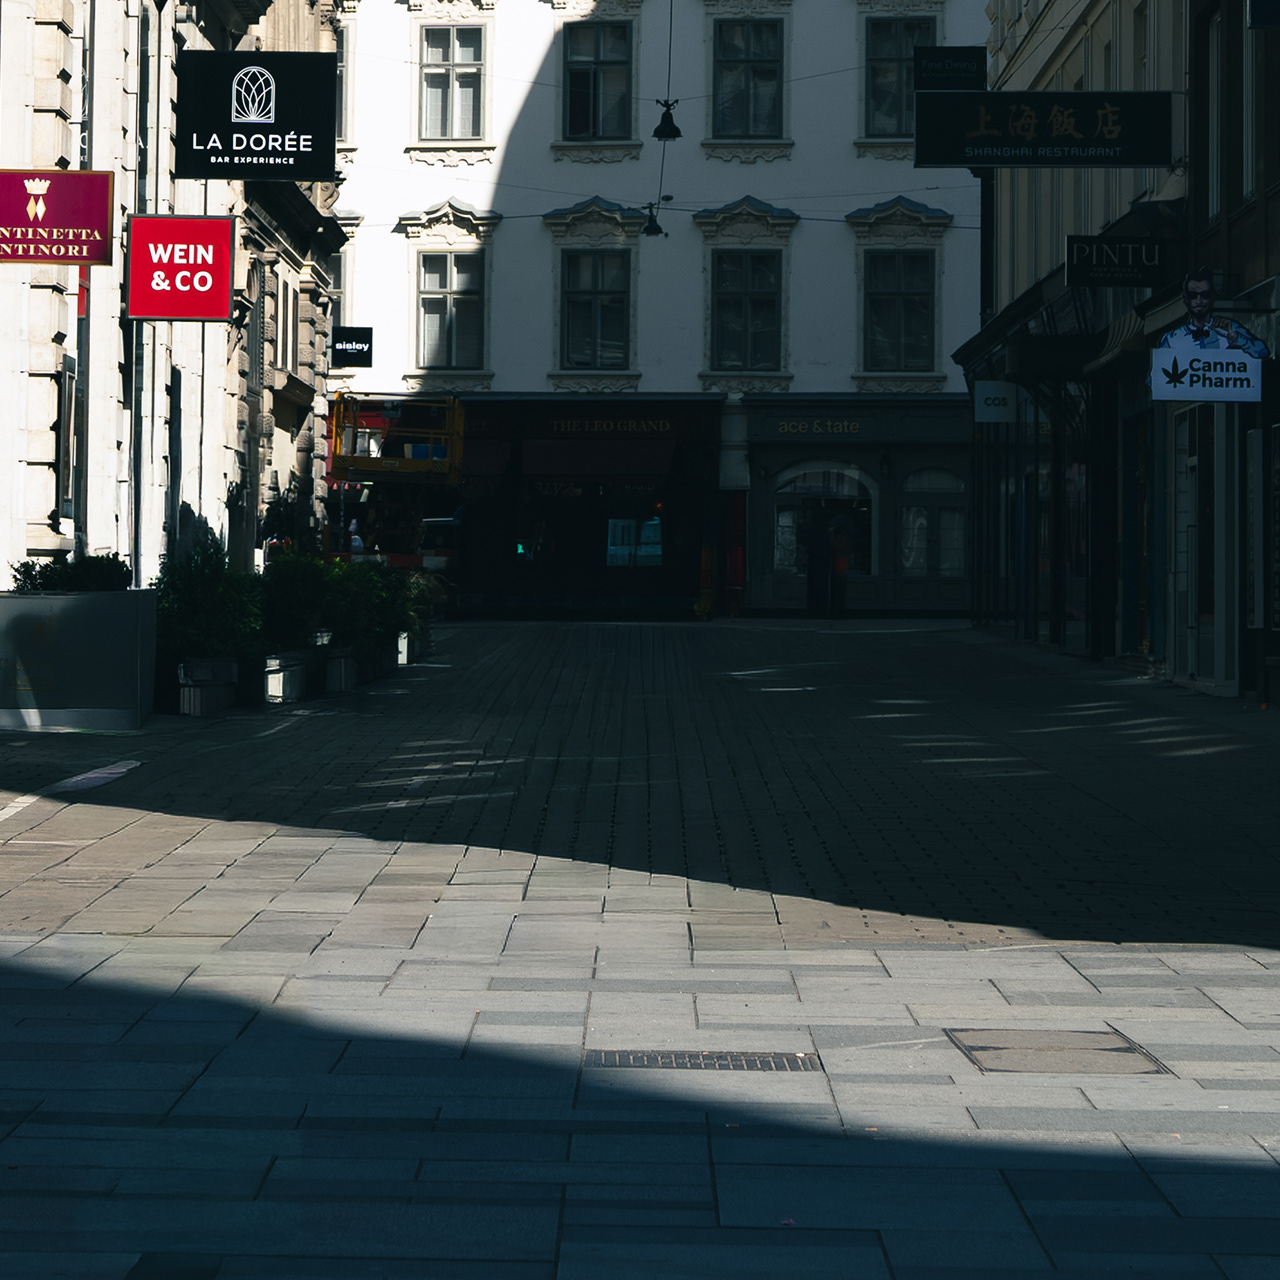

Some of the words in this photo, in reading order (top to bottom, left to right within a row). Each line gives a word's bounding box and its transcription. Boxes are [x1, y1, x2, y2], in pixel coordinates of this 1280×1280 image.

[192, 132, 223, 151] LA
[232, 130, 313, 152] DORÉE
[964, 146, 1033, 158] SHANGHAI
[1037, 146, 1123, 158] RESTAURANT
[210, 156, 230, 164] BAR
[233, 156, 295, 165] EXPERIENCE
[148, 243, 214, 265] WEIN
[1072, 243, 1160, 266] PINTU
[335, 341, 370, 352] sisley
[1188, 358, 1248, 373] Canna
[1188, 373, 1251, 388] Pharm
[550, 419, 581, 433] THE
[584, 419, 615, 433] LEO
[616, 419, 671, 433] GRAND
[778, 421, 809, 434] ace
[812, 419, 824, 434] &
[826, 419, 861, 434] tate
